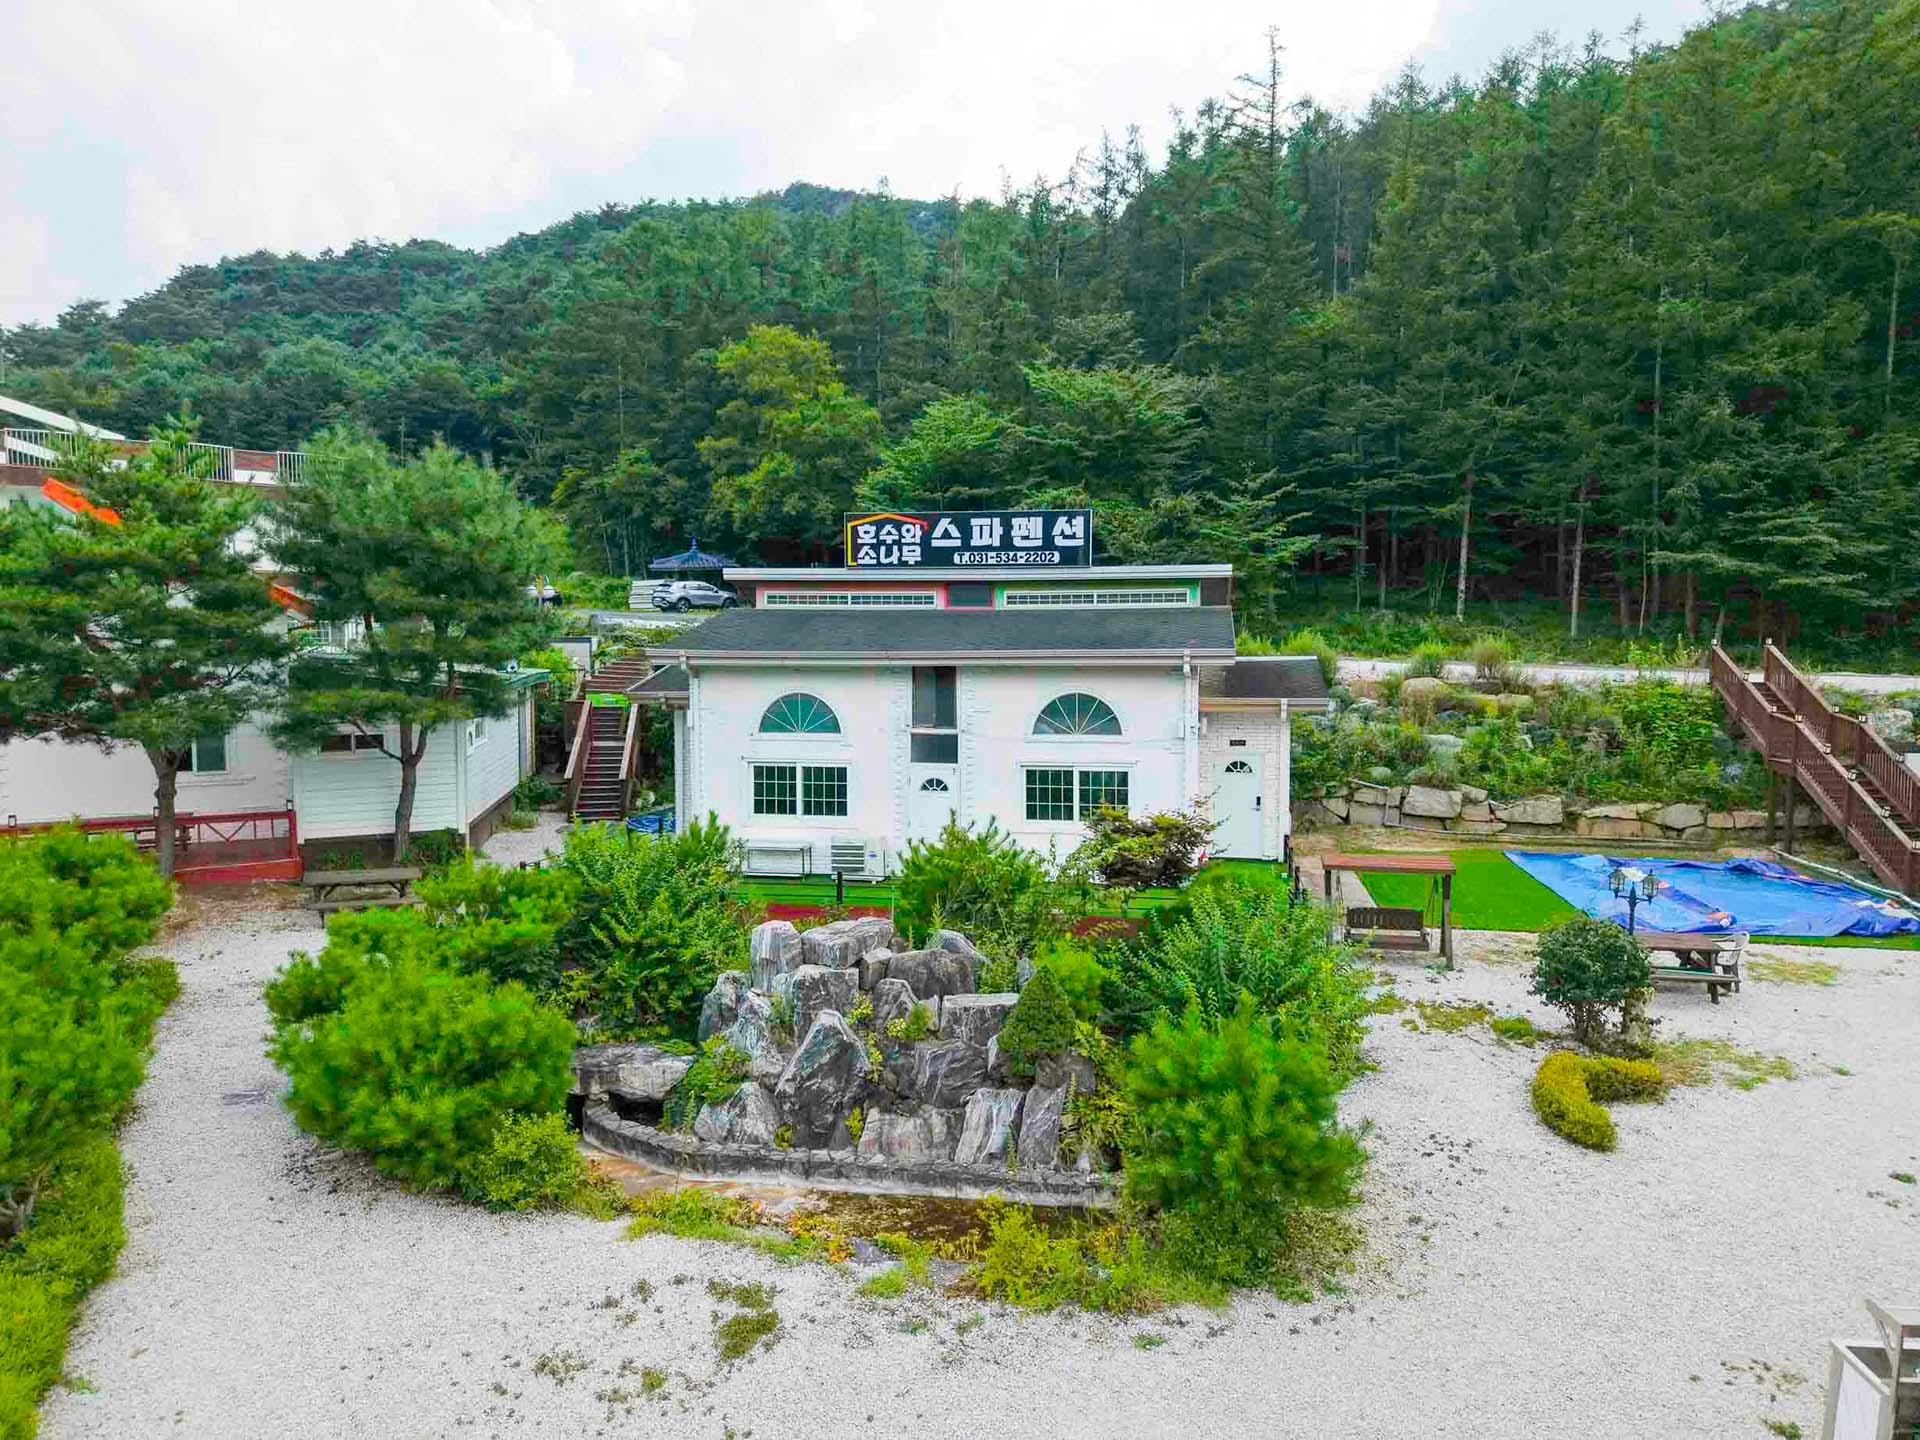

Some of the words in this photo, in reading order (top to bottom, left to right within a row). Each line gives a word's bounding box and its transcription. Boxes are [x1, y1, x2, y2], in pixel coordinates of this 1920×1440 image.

[857, 524, 922, 544] 호수와
[931, 516, 1085, 547] 스파펜션
[857, 545, 921, 565] 소나무
[957, 552, 1056, 564] T.031-534-2202
